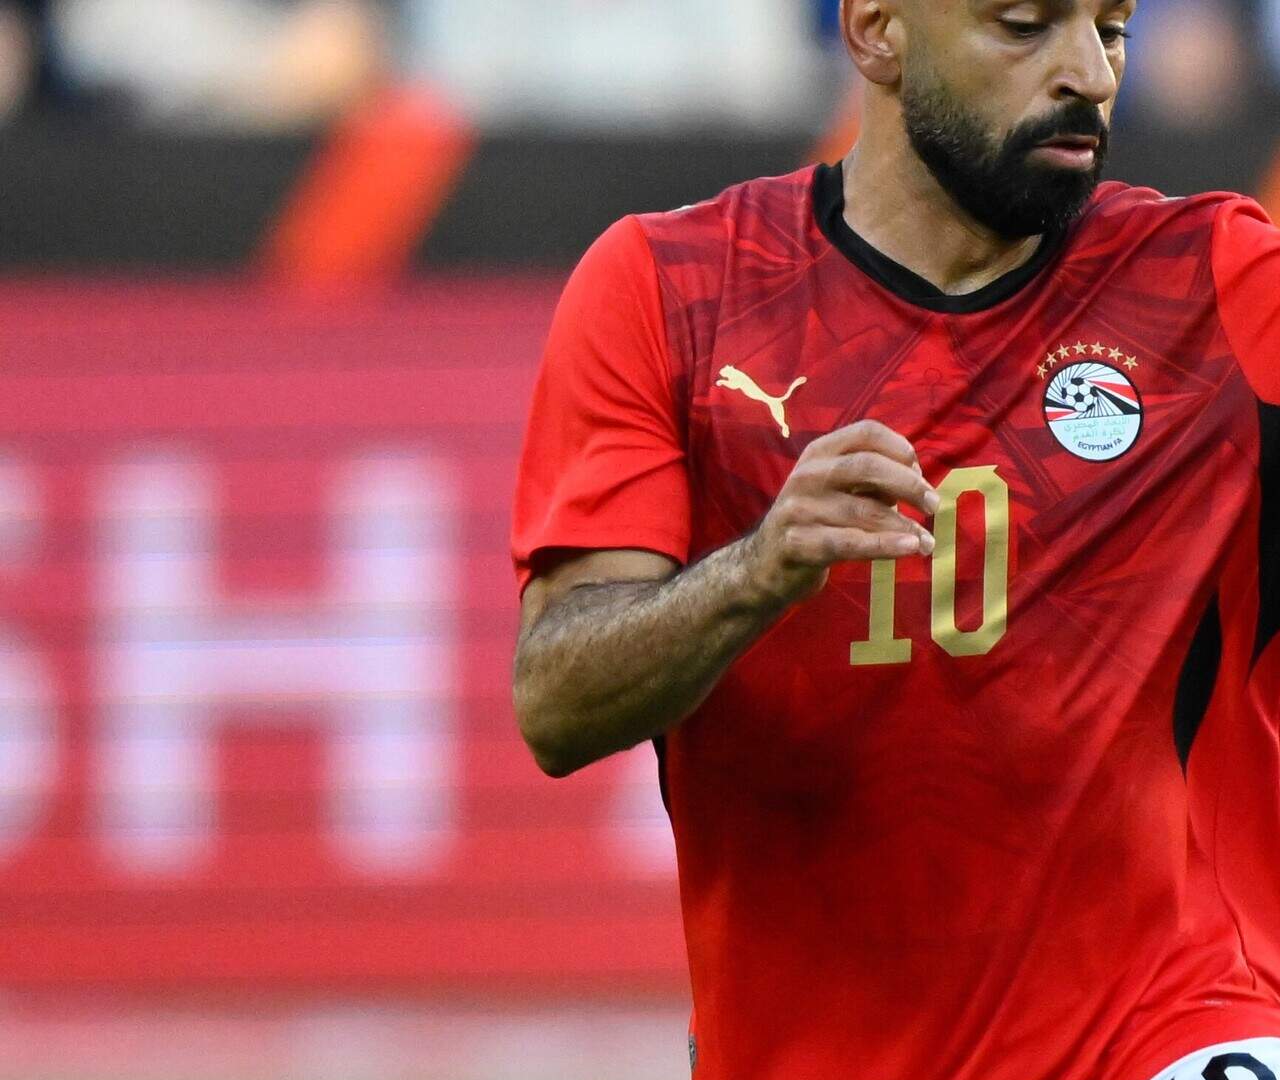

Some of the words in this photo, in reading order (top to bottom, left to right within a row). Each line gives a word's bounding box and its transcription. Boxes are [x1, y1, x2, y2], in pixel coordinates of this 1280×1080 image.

[1078, 441, 1113, 451] EGYPTIAN
[1114, 438, 1123, 447] FA
[850, 464, 1009, 665] 10
